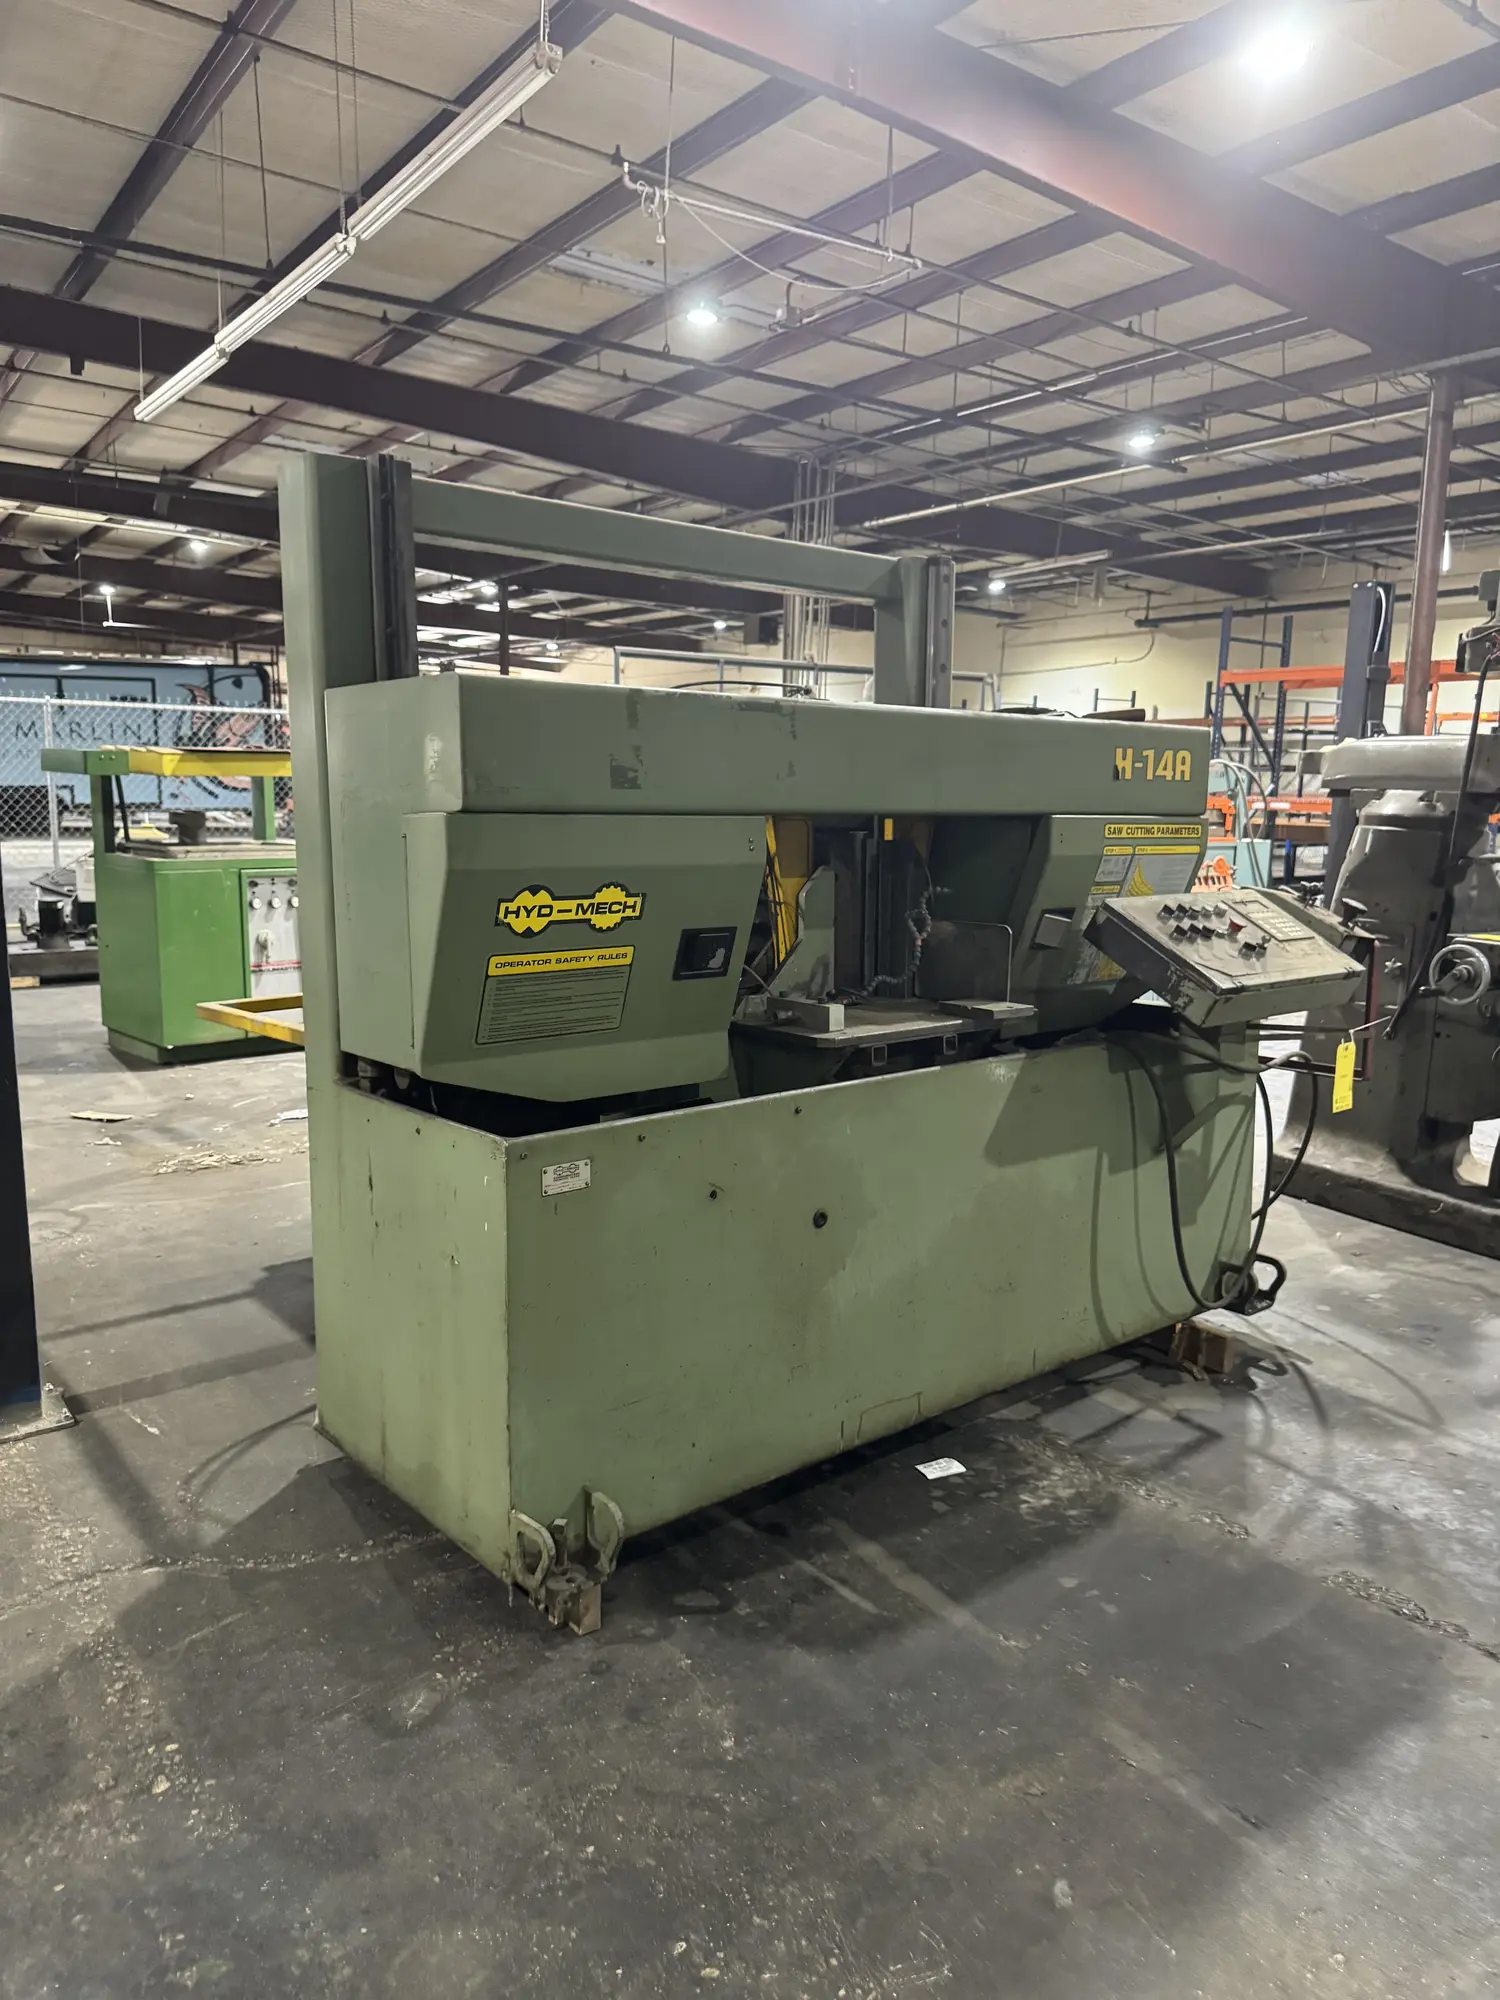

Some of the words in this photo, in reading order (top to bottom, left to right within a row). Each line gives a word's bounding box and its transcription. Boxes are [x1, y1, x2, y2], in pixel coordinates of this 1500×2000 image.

[1115, 748, 1191, 781] H-14A
[1107, 826, 1124, 836] SAW
[1125, 826, 1155, 836] CUTTING
[1156, 826, 1200, 836] PARAMETERS
[495, 958, 552, 969] OPERATOR
[555, 955, 595, 965] SAFETY
[597, 952, 628, 961] RULES
